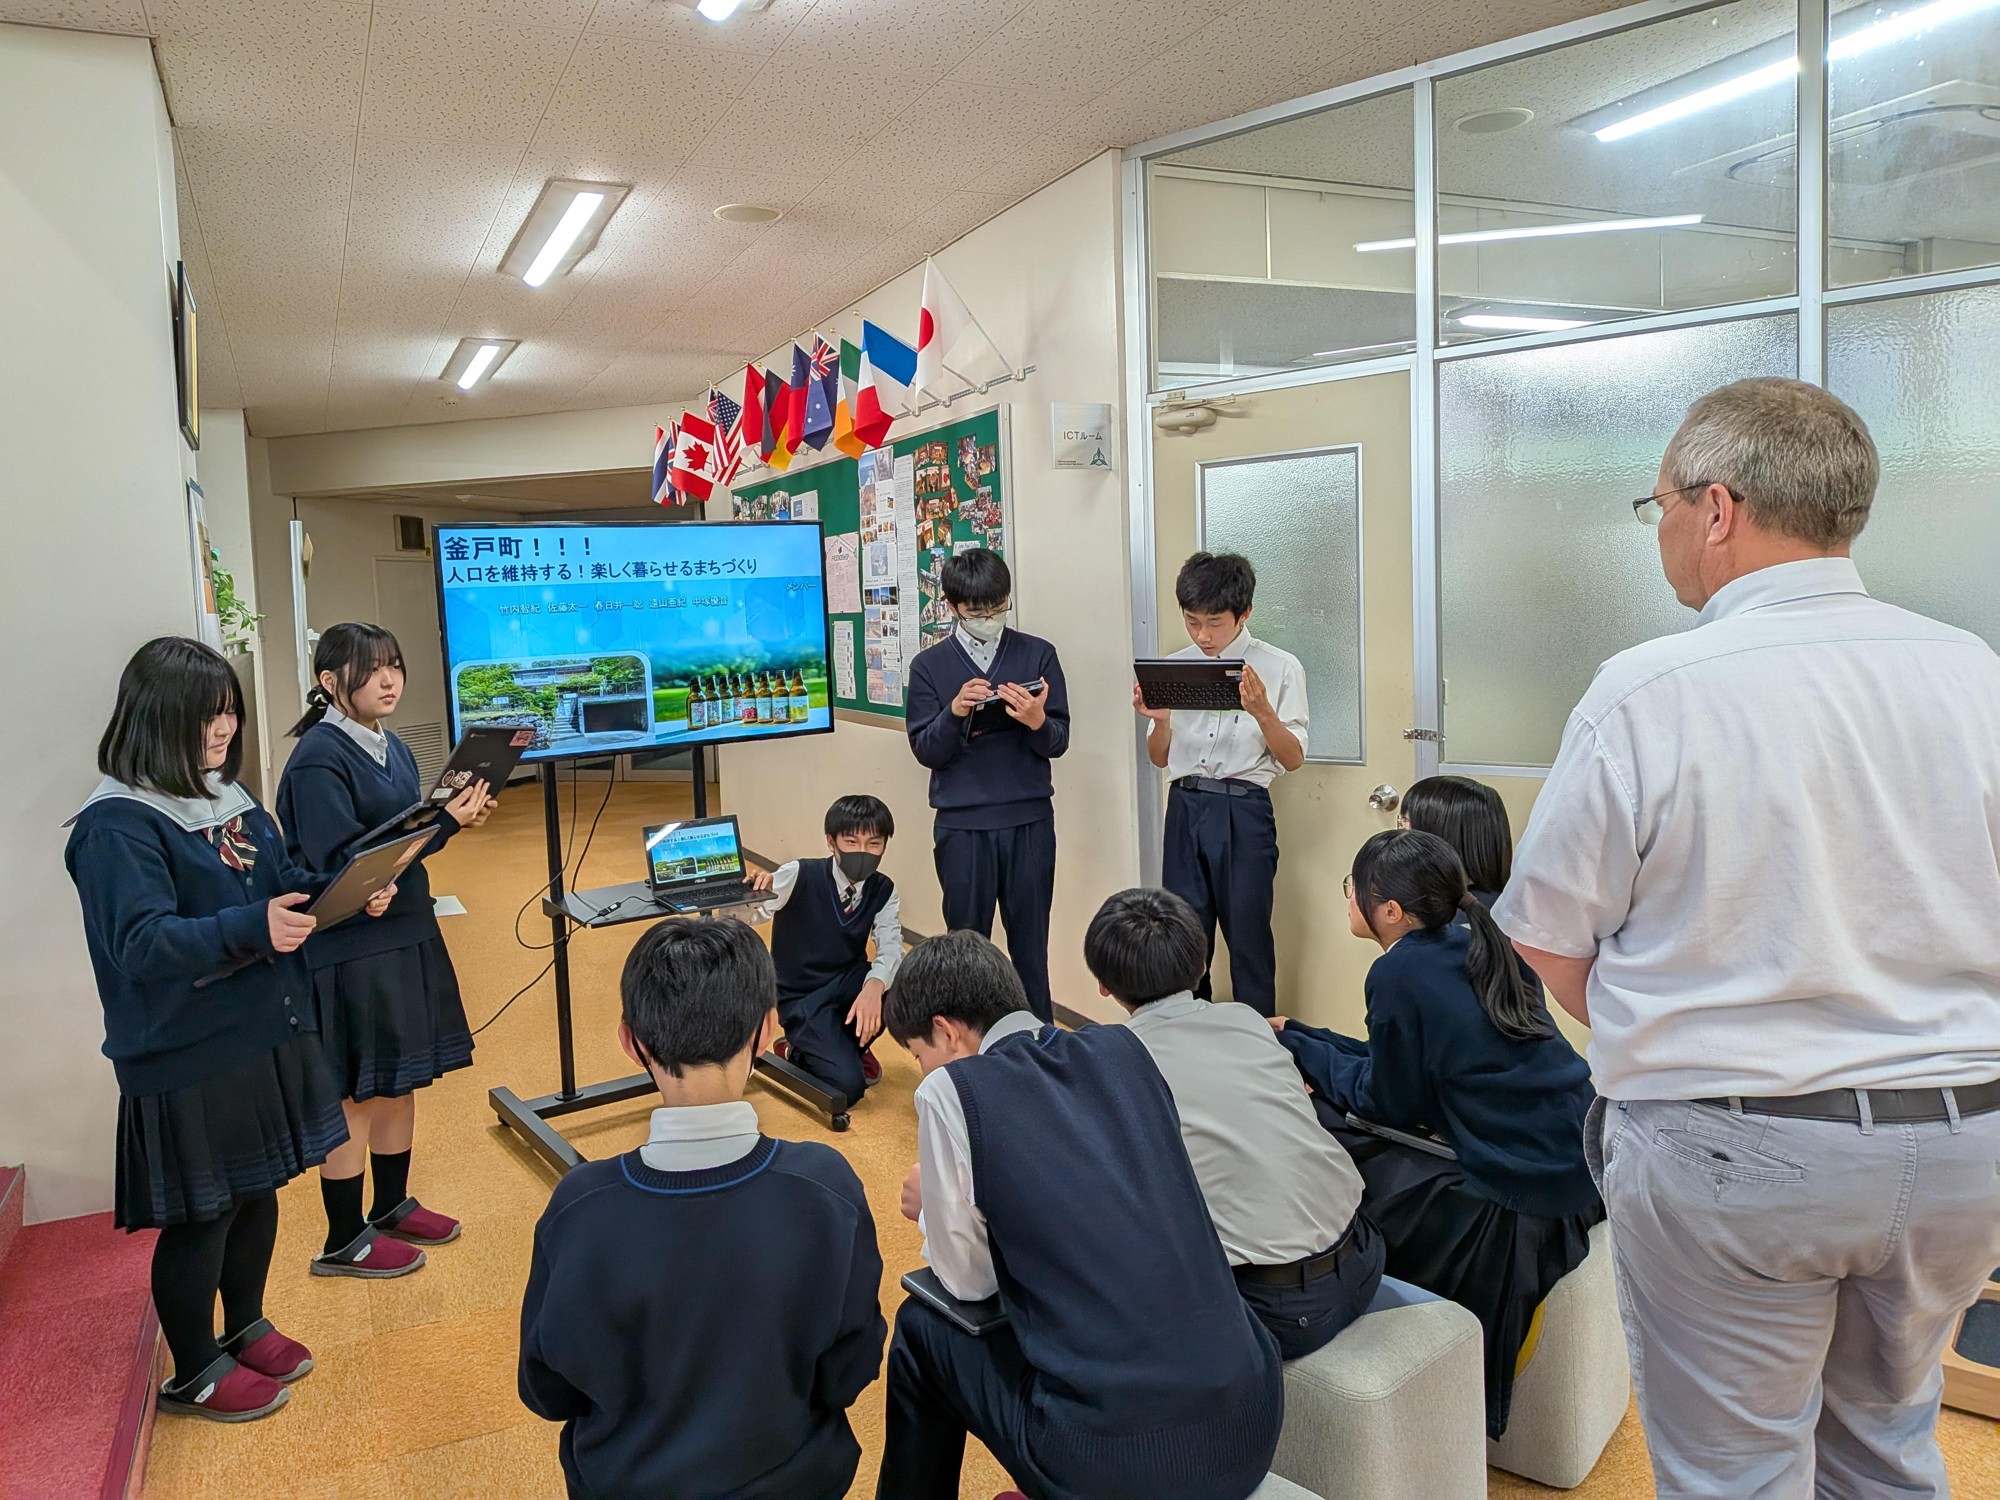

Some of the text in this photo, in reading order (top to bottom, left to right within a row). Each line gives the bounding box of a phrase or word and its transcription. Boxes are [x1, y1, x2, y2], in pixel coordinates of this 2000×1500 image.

[1063, 430, 1103, 441] ICTルーム
[444, 536, 592, 561] 釜戸町！！！
[446, 558, 758, 584] 人口を維持する！楽しく暮らせるまちづくり
[786, 581, 817, 592] メンバー
[547, 601, 588, 613] 佐藤太一
